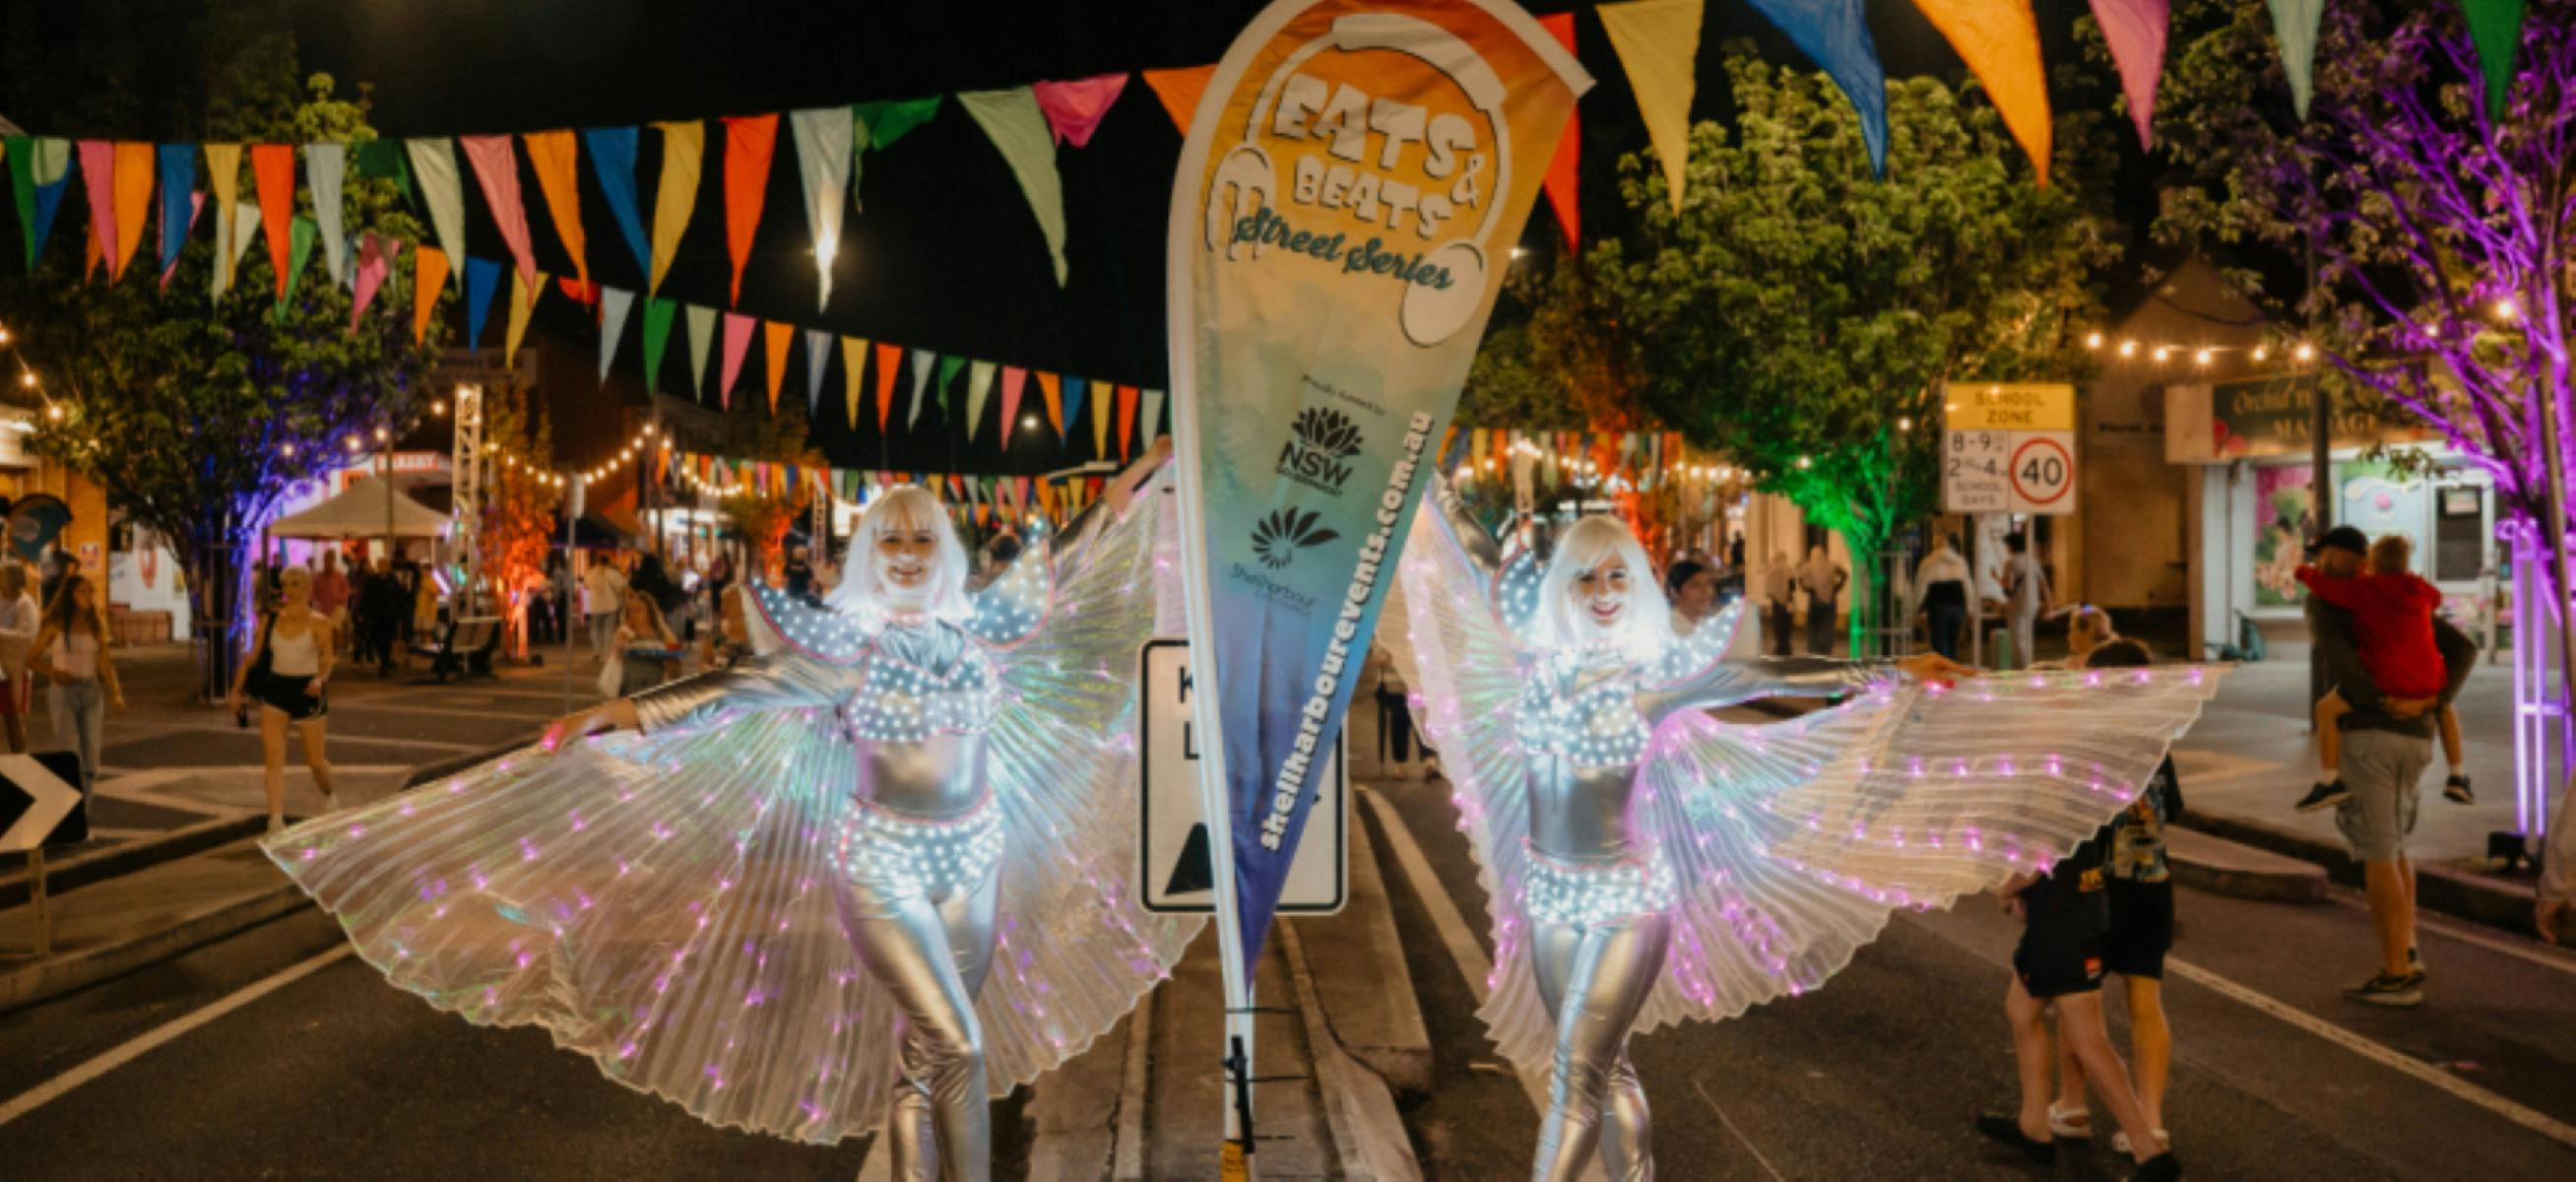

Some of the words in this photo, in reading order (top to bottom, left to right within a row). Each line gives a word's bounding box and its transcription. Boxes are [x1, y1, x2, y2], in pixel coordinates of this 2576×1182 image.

[1273, 73, 1477, 180] EATS
[1450, 154, 1486, 209] &
[1293, 156, 1451, 239] BEATS
[1235, 207, 1346, 262] Street
[1342, 237, 1456, 290] Series
[1974, 392, 2045, 406] SCHOOL
[1986, 410, 2033, 424] ZONE
[1279, 440, 1355, 488] NSW
[2022, 457, 2063, 487] 40
[1259, 410, 1434, 854] shellharbourevents.com.au
